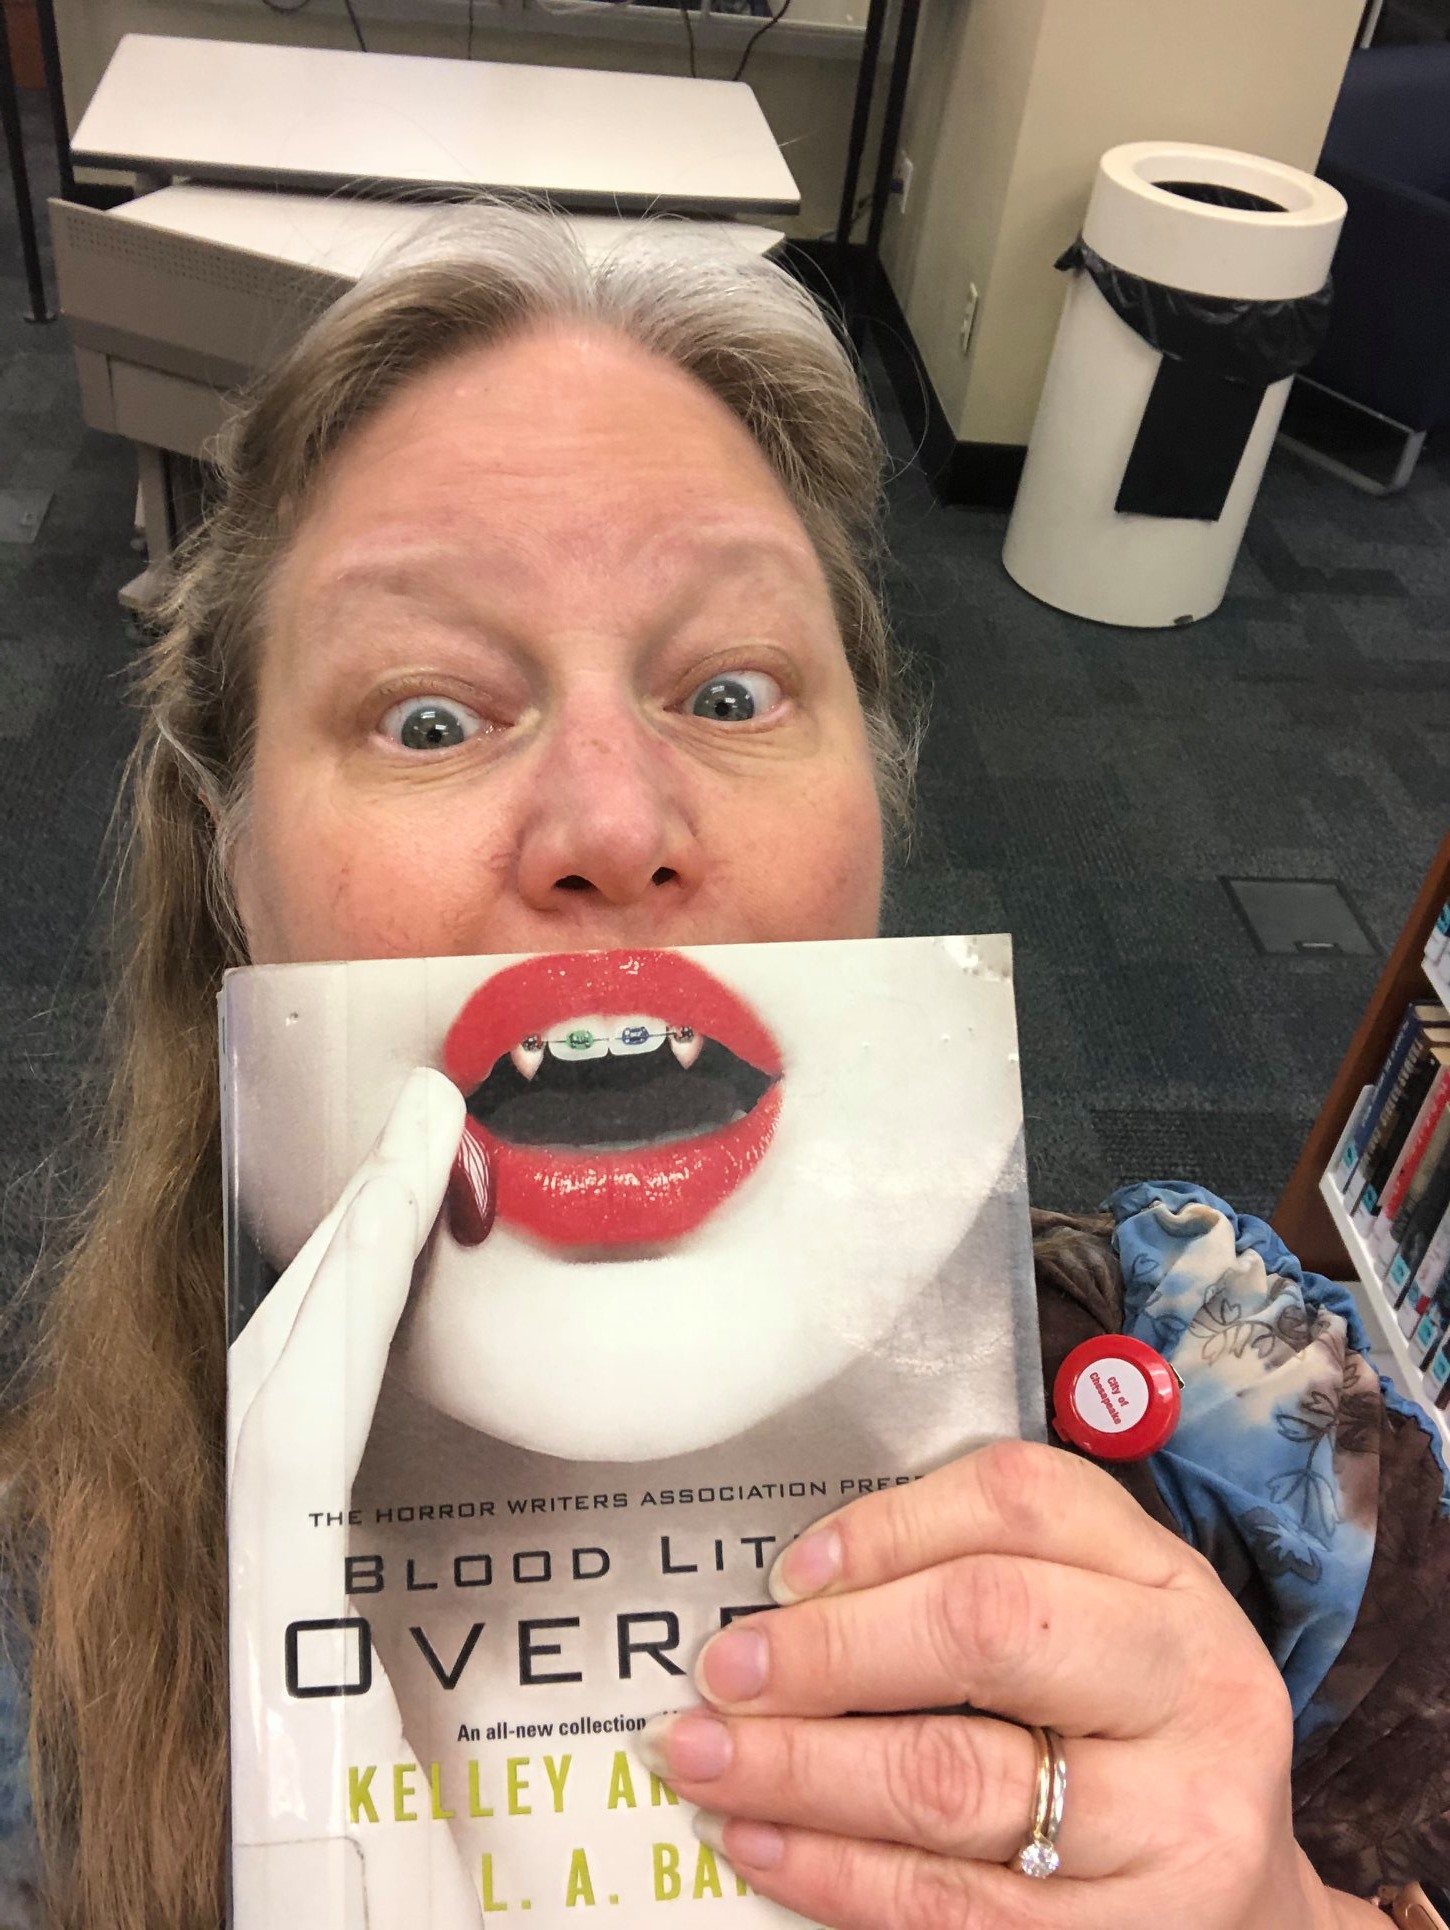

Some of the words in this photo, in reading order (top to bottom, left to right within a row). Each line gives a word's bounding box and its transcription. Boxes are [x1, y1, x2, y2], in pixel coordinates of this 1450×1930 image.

[1090, 1372, 1121, 1424] Chesapeake
[1107, 1377, 1121, 1394] City
[1118, 1397, 1129, 1406] of
[308, 1510, 363, 1528] THE
[376, 1501, 496, 1524] HORROR
[507, 1491, 628, 1514] WRITERS
[640, 1480, 827, 1506] ASSOCIATION
[344, 1548, 611, 1595] BLOOD
[660, 1534, 800, 1574] LIT
[284, 1602, 782, 1699] OVER
[457, 1724, 481, 1742] An
[486, 1722, 554, 1740] all-new
[558, 1714, 648, 1736] collection
[348, 1754, 573, 1824] KELLEY
[481, 1852, 532, 1912] L.
[565, 1847, 619, 1908] A.
[652, 1842, 749, 1901] BA
